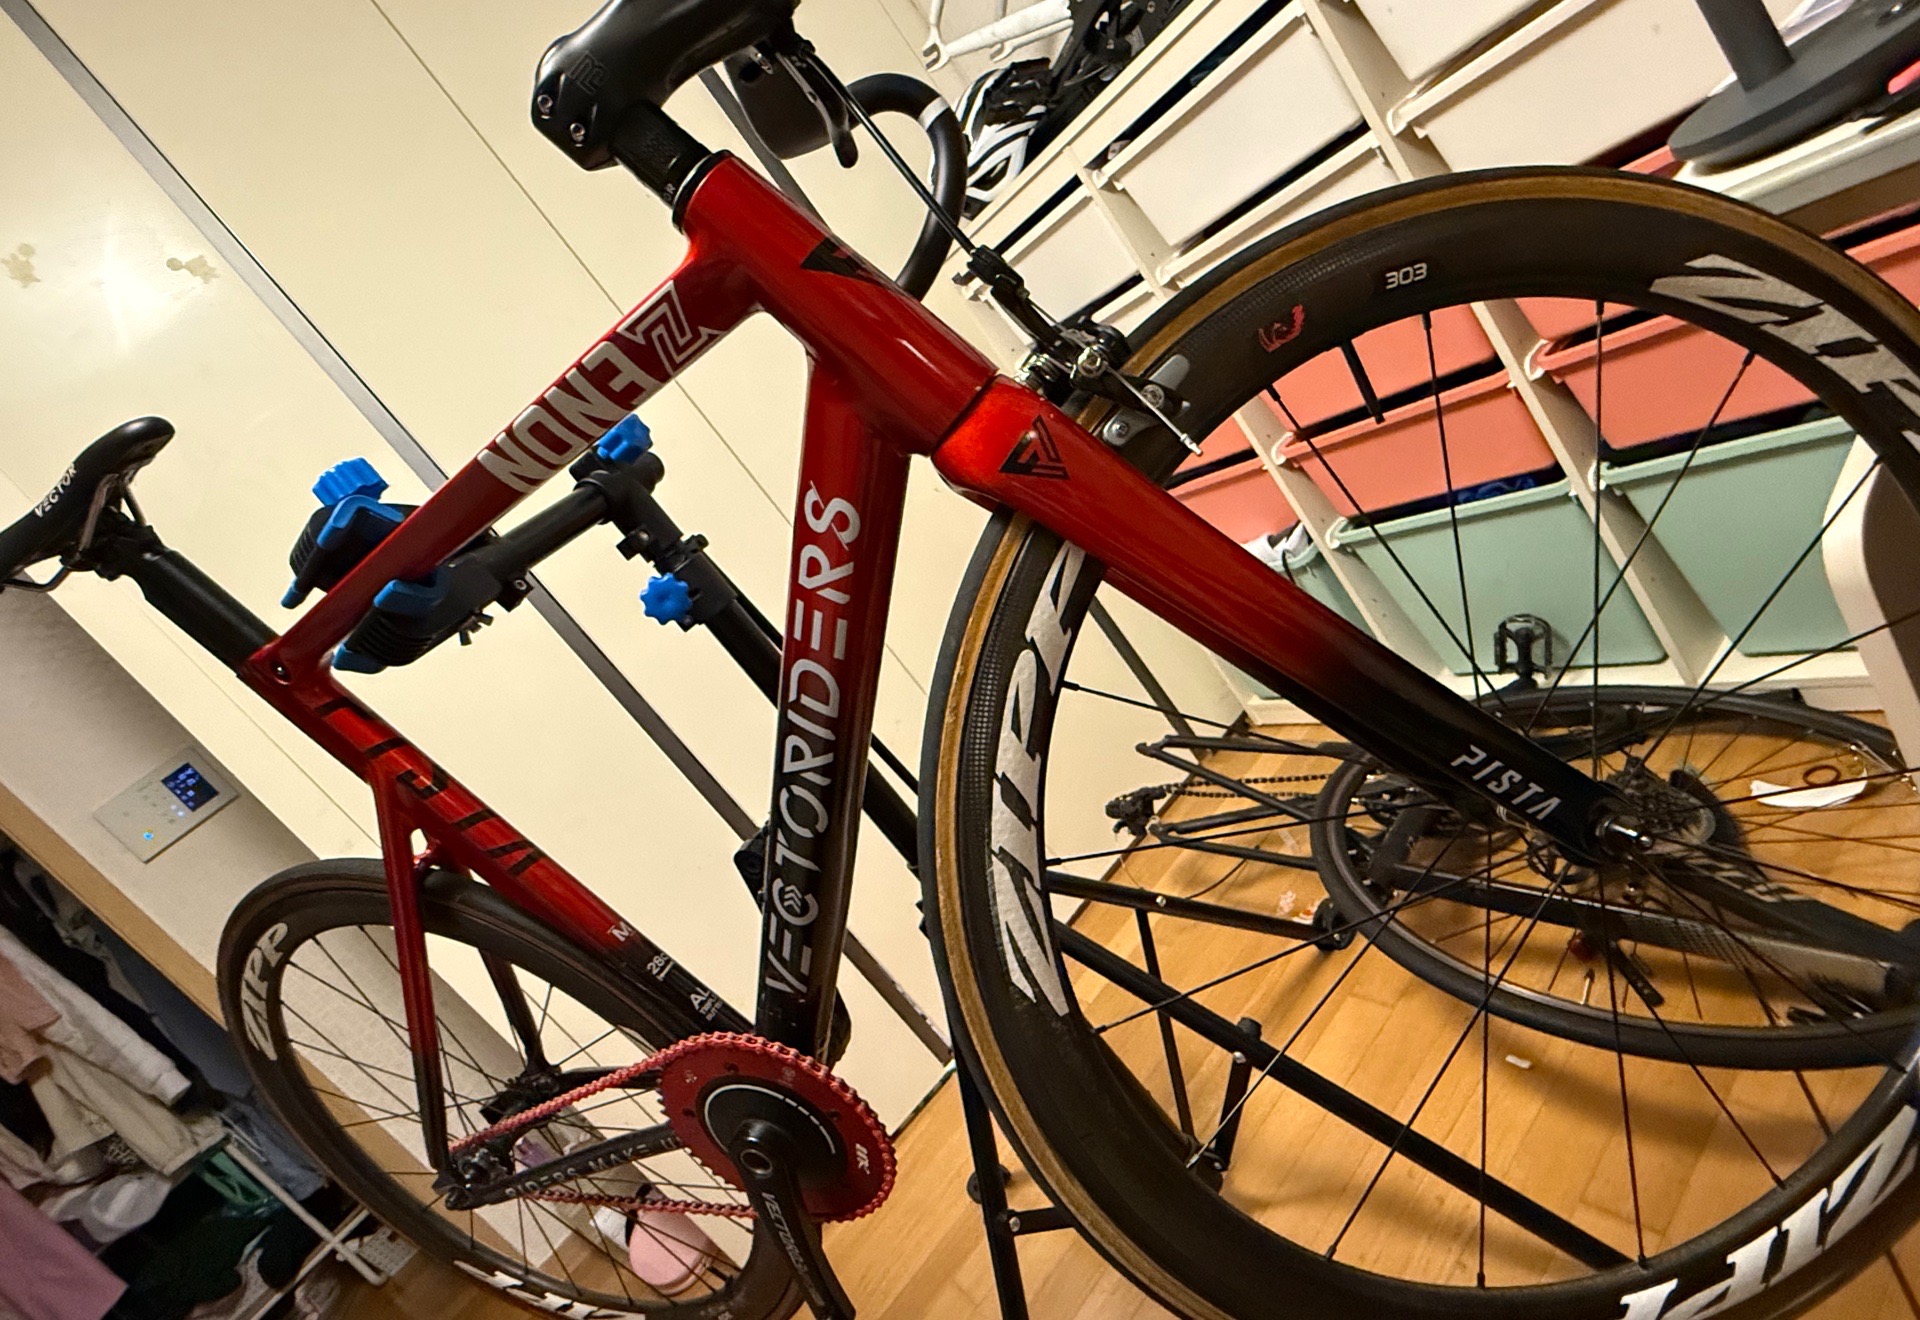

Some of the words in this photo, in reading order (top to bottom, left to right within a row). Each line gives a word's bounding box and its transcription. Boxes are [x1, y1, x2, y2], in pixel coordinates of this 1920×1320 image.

[1385, 262, 1427, 289] 303
[1650, 253, 1920, 455] ZIP
[34, 462, 77, 518] VECTOR
[1450, 744, 1561, 820] PISTA
[241, 922, 288, 1061] ZIPP
